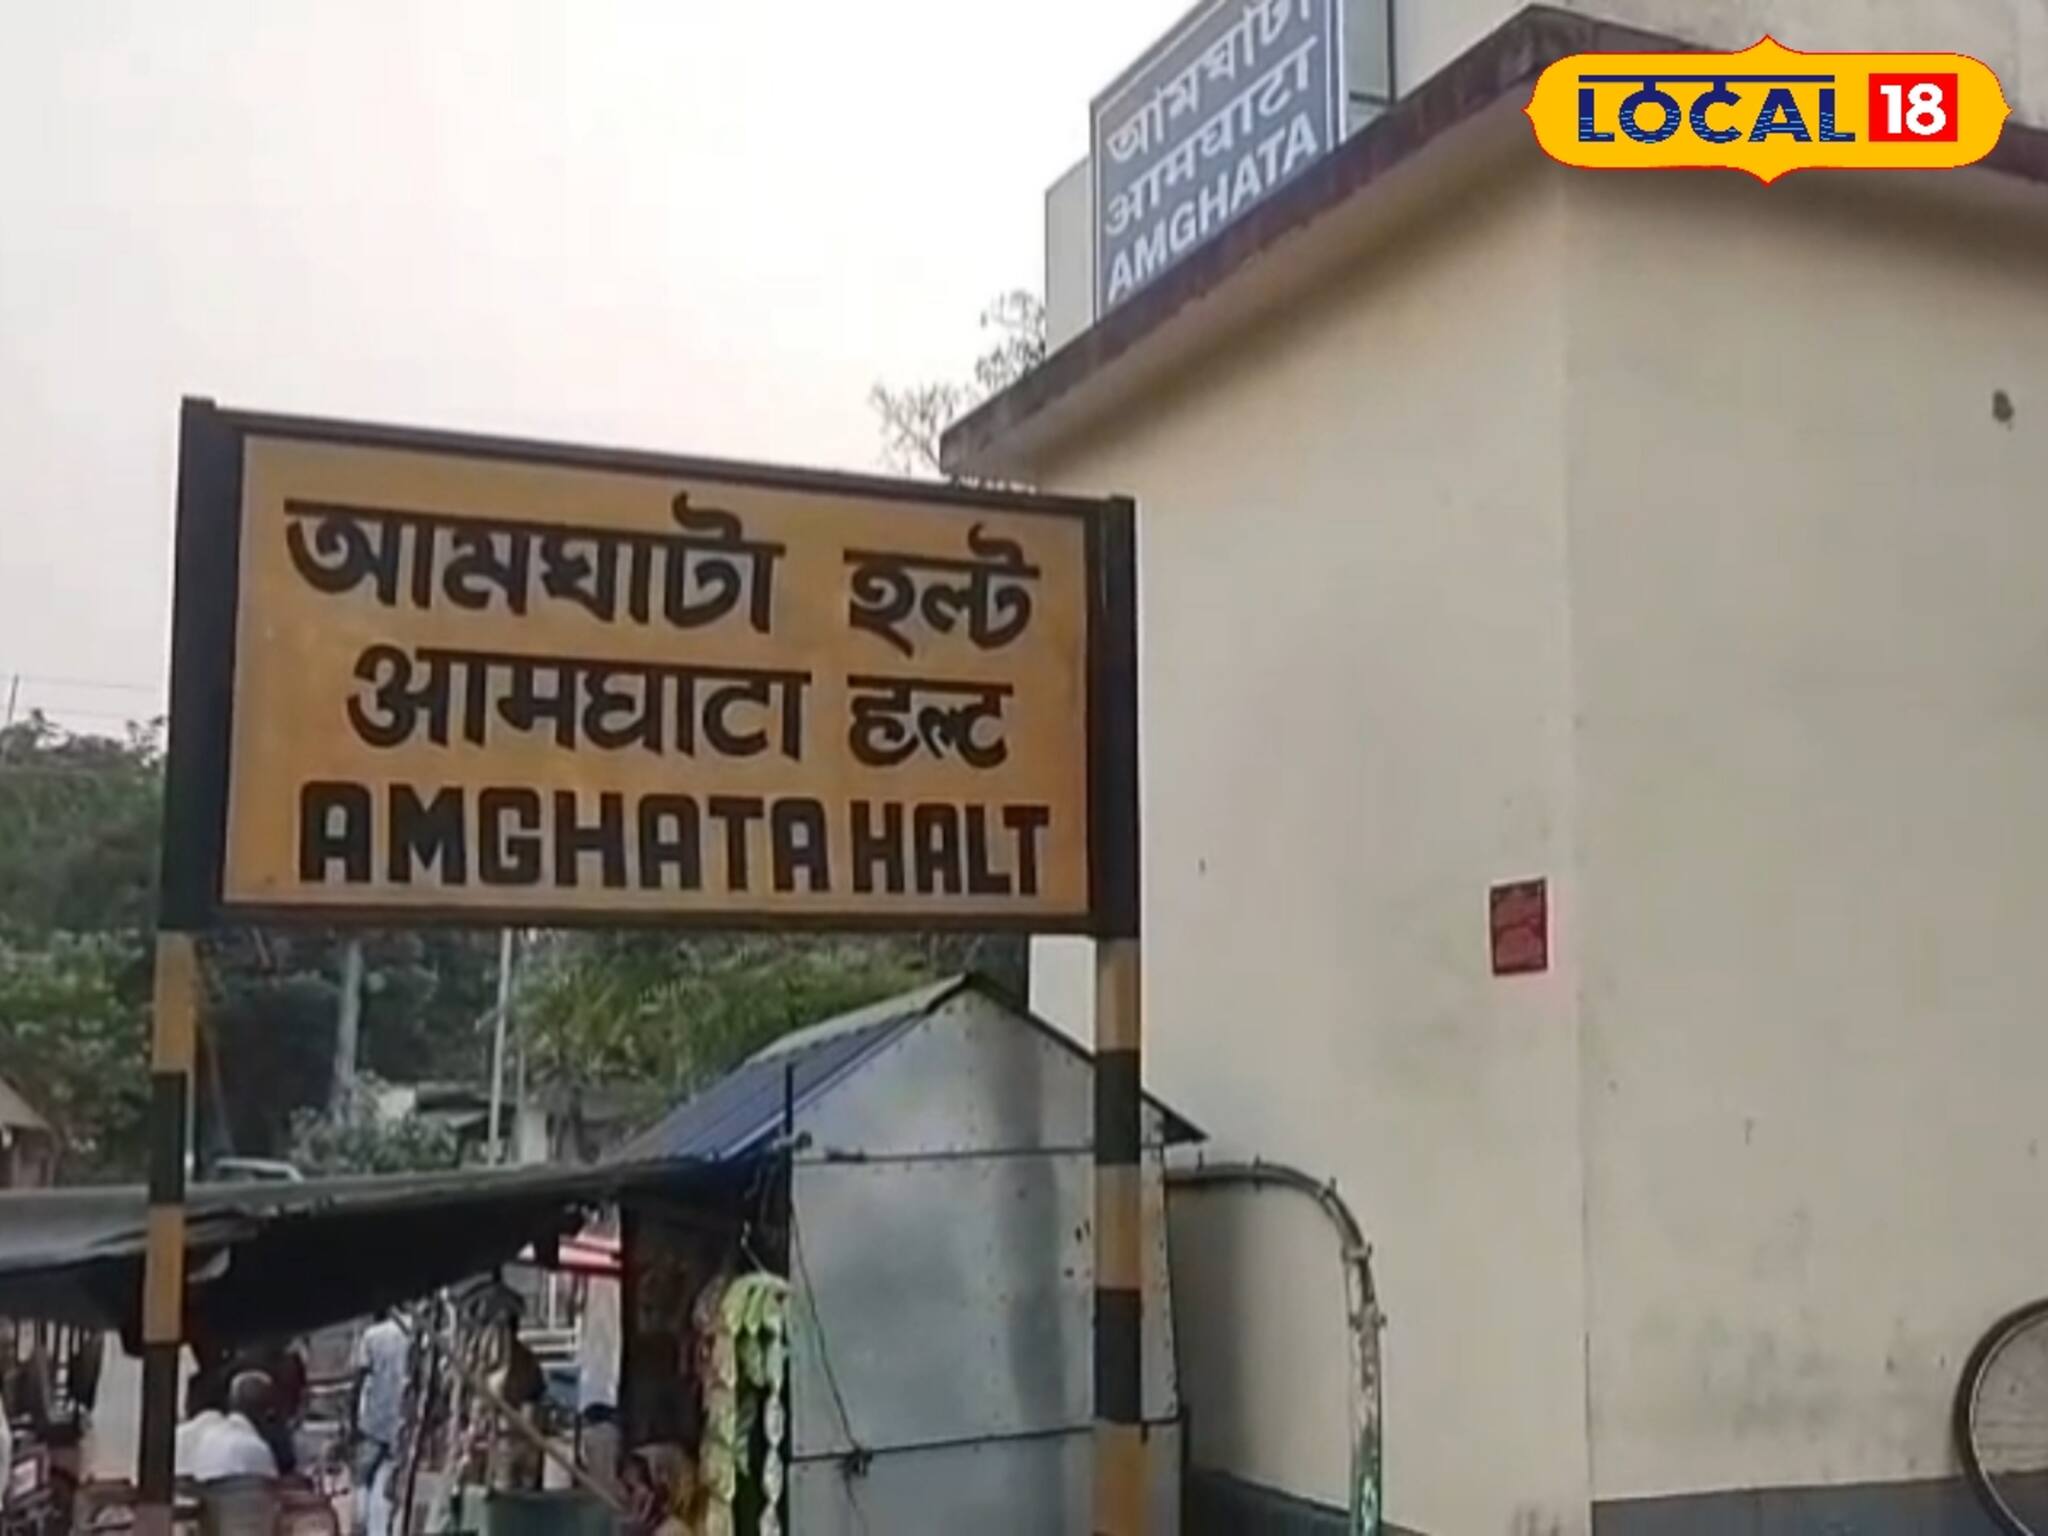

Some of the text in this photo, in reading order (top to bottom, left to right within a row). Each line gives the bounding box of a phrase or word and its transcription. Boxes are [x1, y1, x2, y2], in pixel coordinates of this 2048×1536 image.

[1105, 35, 1318, 235] आमघाटा
[1108, 112, 1318, 304] AMGHATA
[284, 492, 1040, 657] আমঘাটা হল্ট
[347, 644, 1013, 768] आमघाटा हल्ट
[299, 781, 1049, 896] AMGHATA HALT
